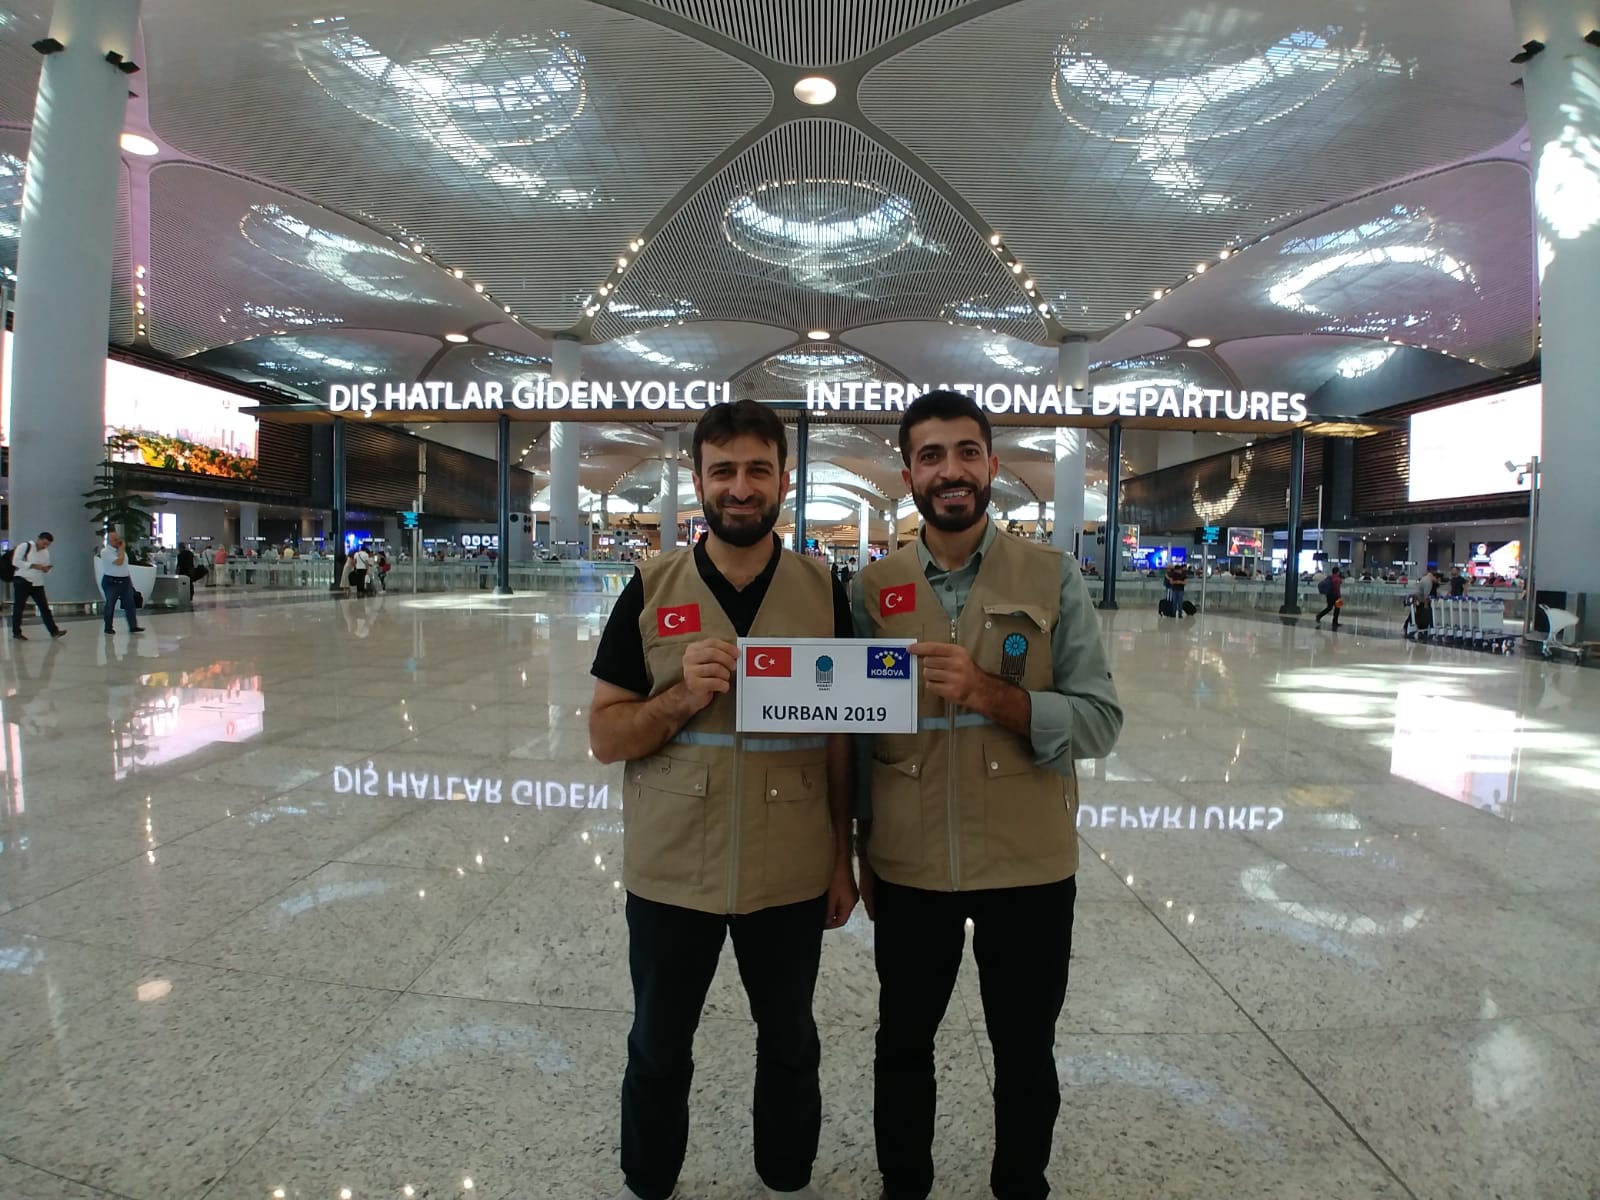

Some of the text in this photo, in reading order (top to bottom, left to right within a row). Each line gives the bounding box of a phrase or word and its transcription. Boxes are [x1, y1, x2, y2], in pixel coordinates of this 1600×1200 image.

[329, 375, 730, 417] DIŞ HATLAR GİDEN YOLCU
[1091, 384, 1307, 422] DEPARTURES
[870, 668, 904, 677] KOSOVA
[762, 705, 887, 722] KURBAN 2019
